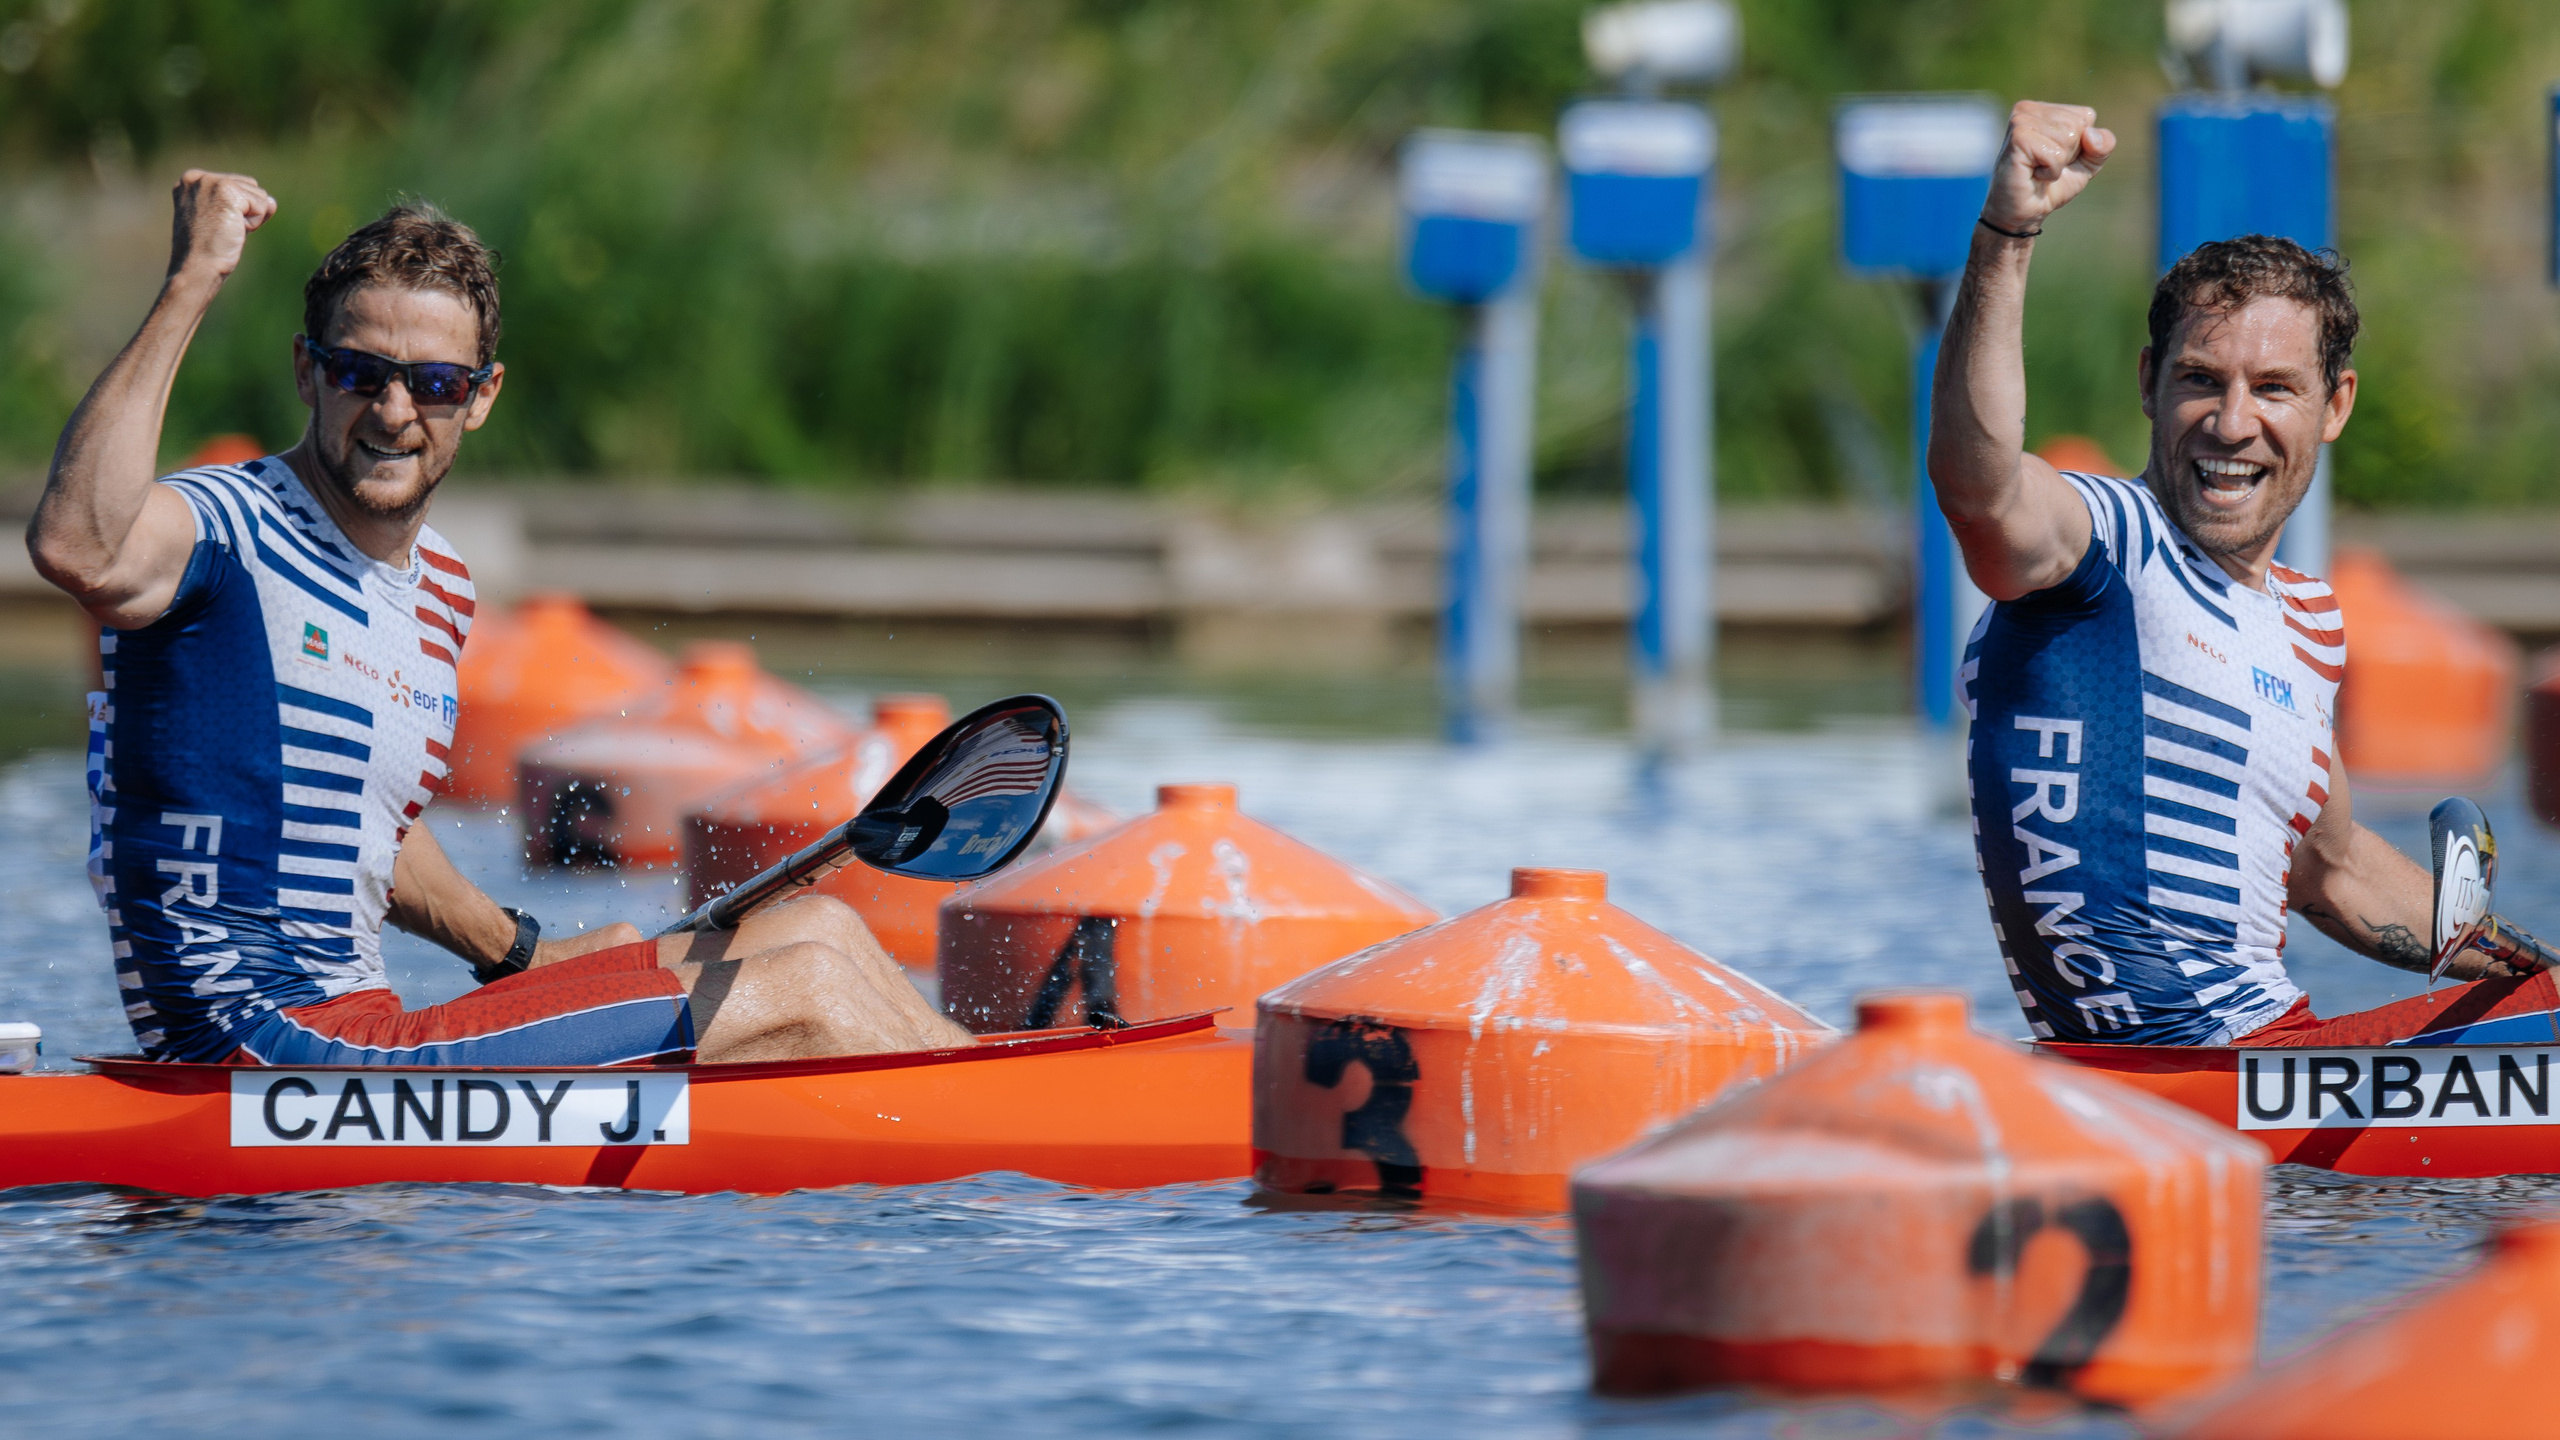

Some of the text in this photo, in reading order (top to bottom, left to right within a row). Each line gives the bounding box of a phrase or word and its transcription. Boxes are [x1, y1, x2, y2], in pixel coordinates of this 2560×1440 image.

[343, 653, 380, 680] NELO
[2187, 632, 2227, 664] NELO
[2251, 665, 2296, 711] FFCK
[2010, 715, 2143, 1035] FRANCE
[263, 1077, 666, 1142] CANDY J.
[1305, 1014, 1423, 1199] 3
[2245, 1053, 2549, 1121] URBAN
[1966, 1195, 2132, 1405] 2
